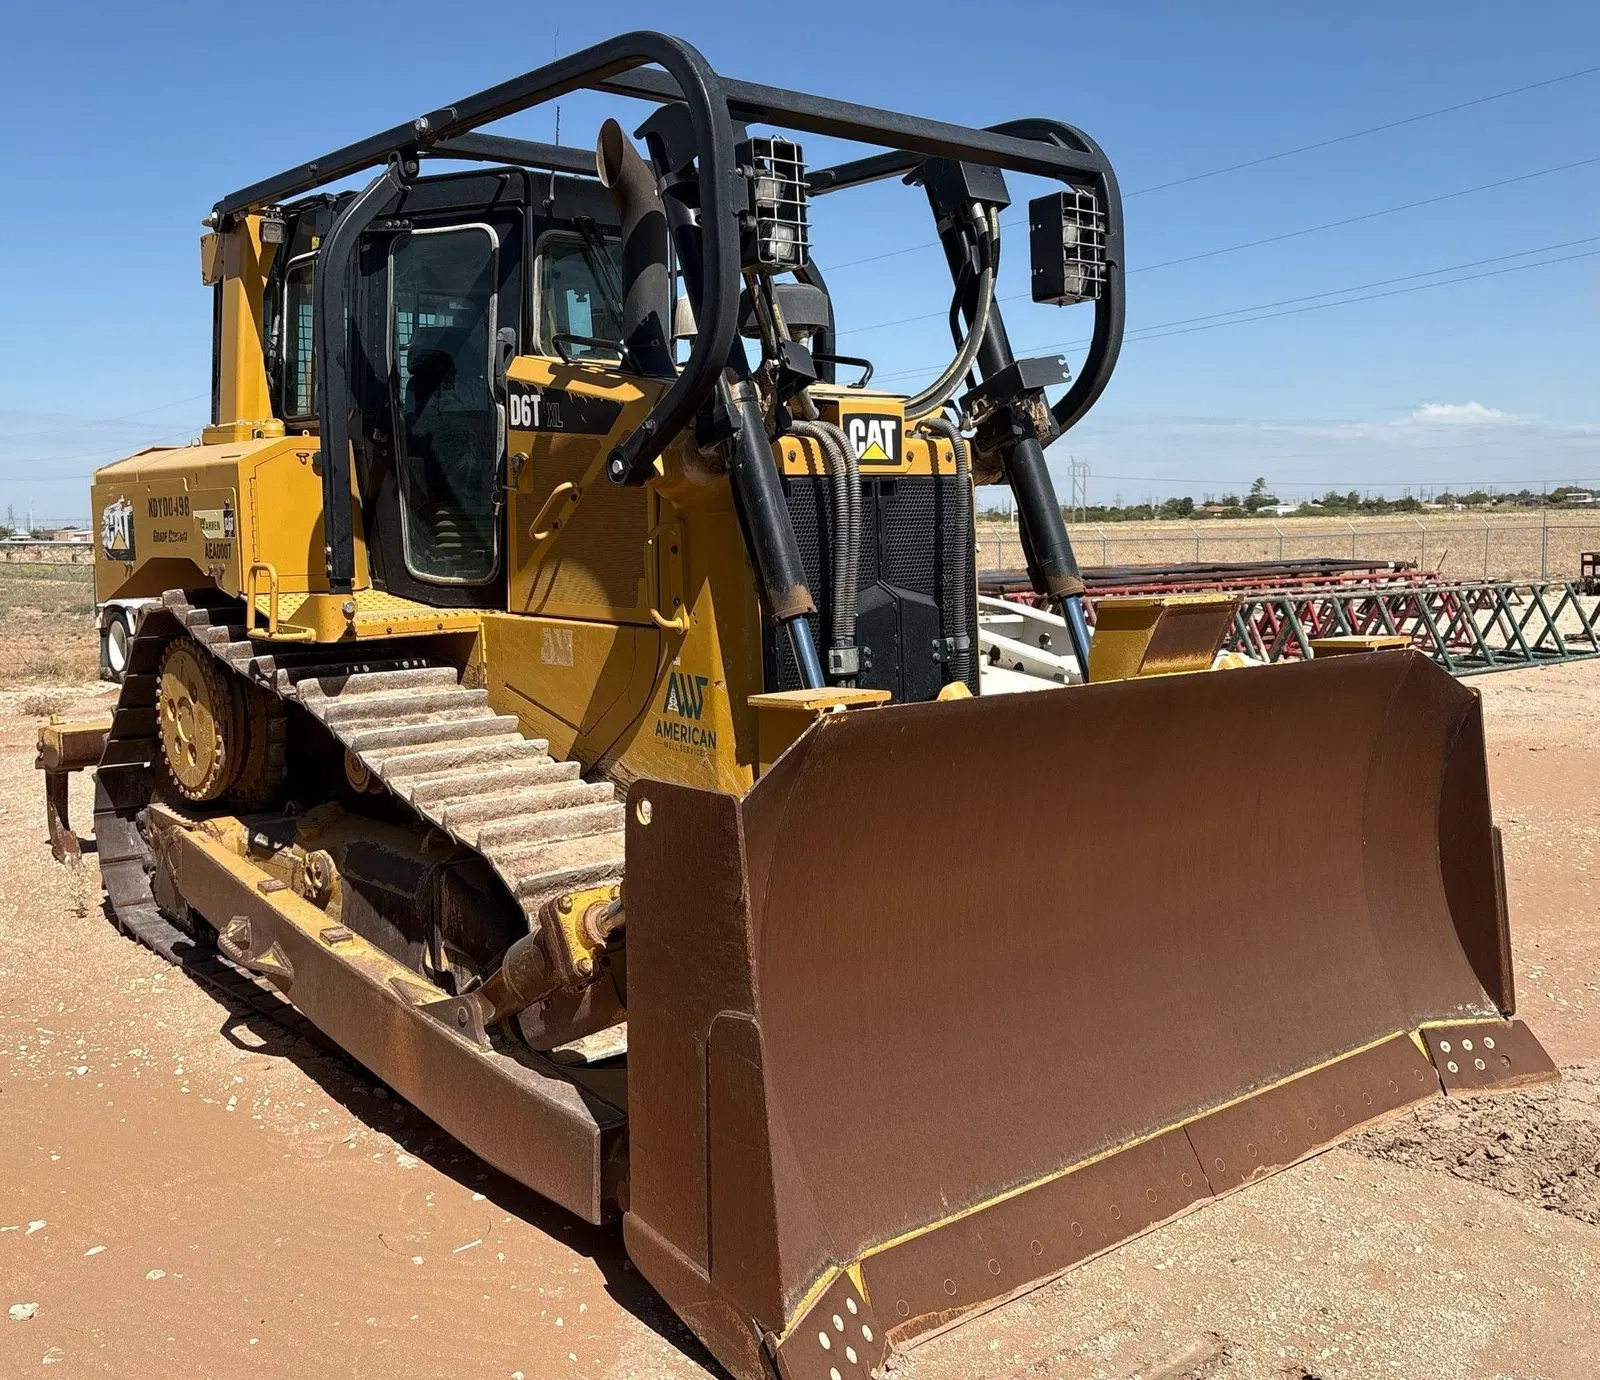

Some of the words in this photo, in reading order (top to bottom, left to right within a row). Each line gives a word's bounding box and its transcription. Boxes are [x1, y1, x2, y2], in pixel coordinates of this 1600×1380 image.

[510, 394, 541, 427] D6T
[546, 402, 563, 428] XL
[849, 418, 896, 460] CAT
[655, 719, 717, 749] AMERICAN
